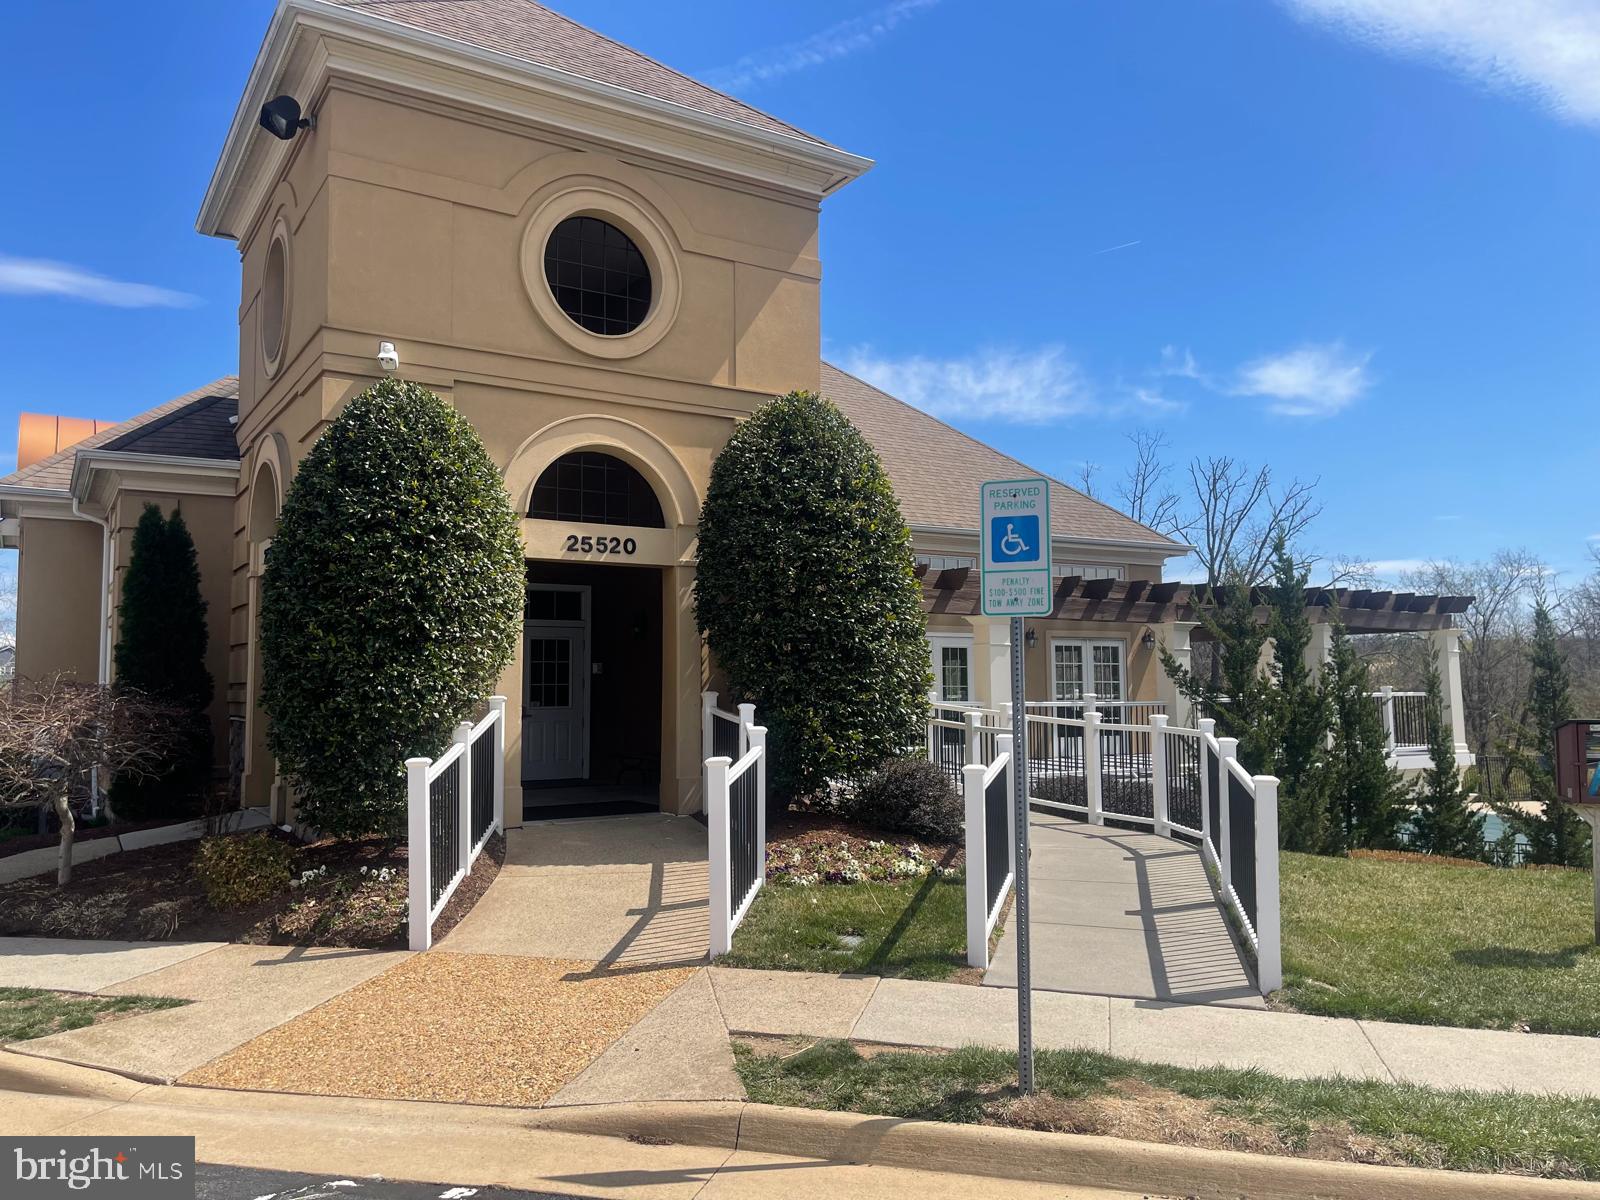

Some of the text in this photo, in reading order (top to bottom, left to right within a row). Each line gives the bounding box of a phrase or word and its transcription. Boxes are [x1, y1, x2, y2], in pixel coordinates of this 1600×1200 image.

[990, 487, 1040, 498] RESERVED
[994, 500, 1036, 510] PARKING
[566, 534, 637, 555] 25520
[1002, 577, 1029, 586] PENALTY
[989, 587, 1044, 597] $100-$500 FINE
[989, 597, 1044, 608] TOW AWAY ZONE
